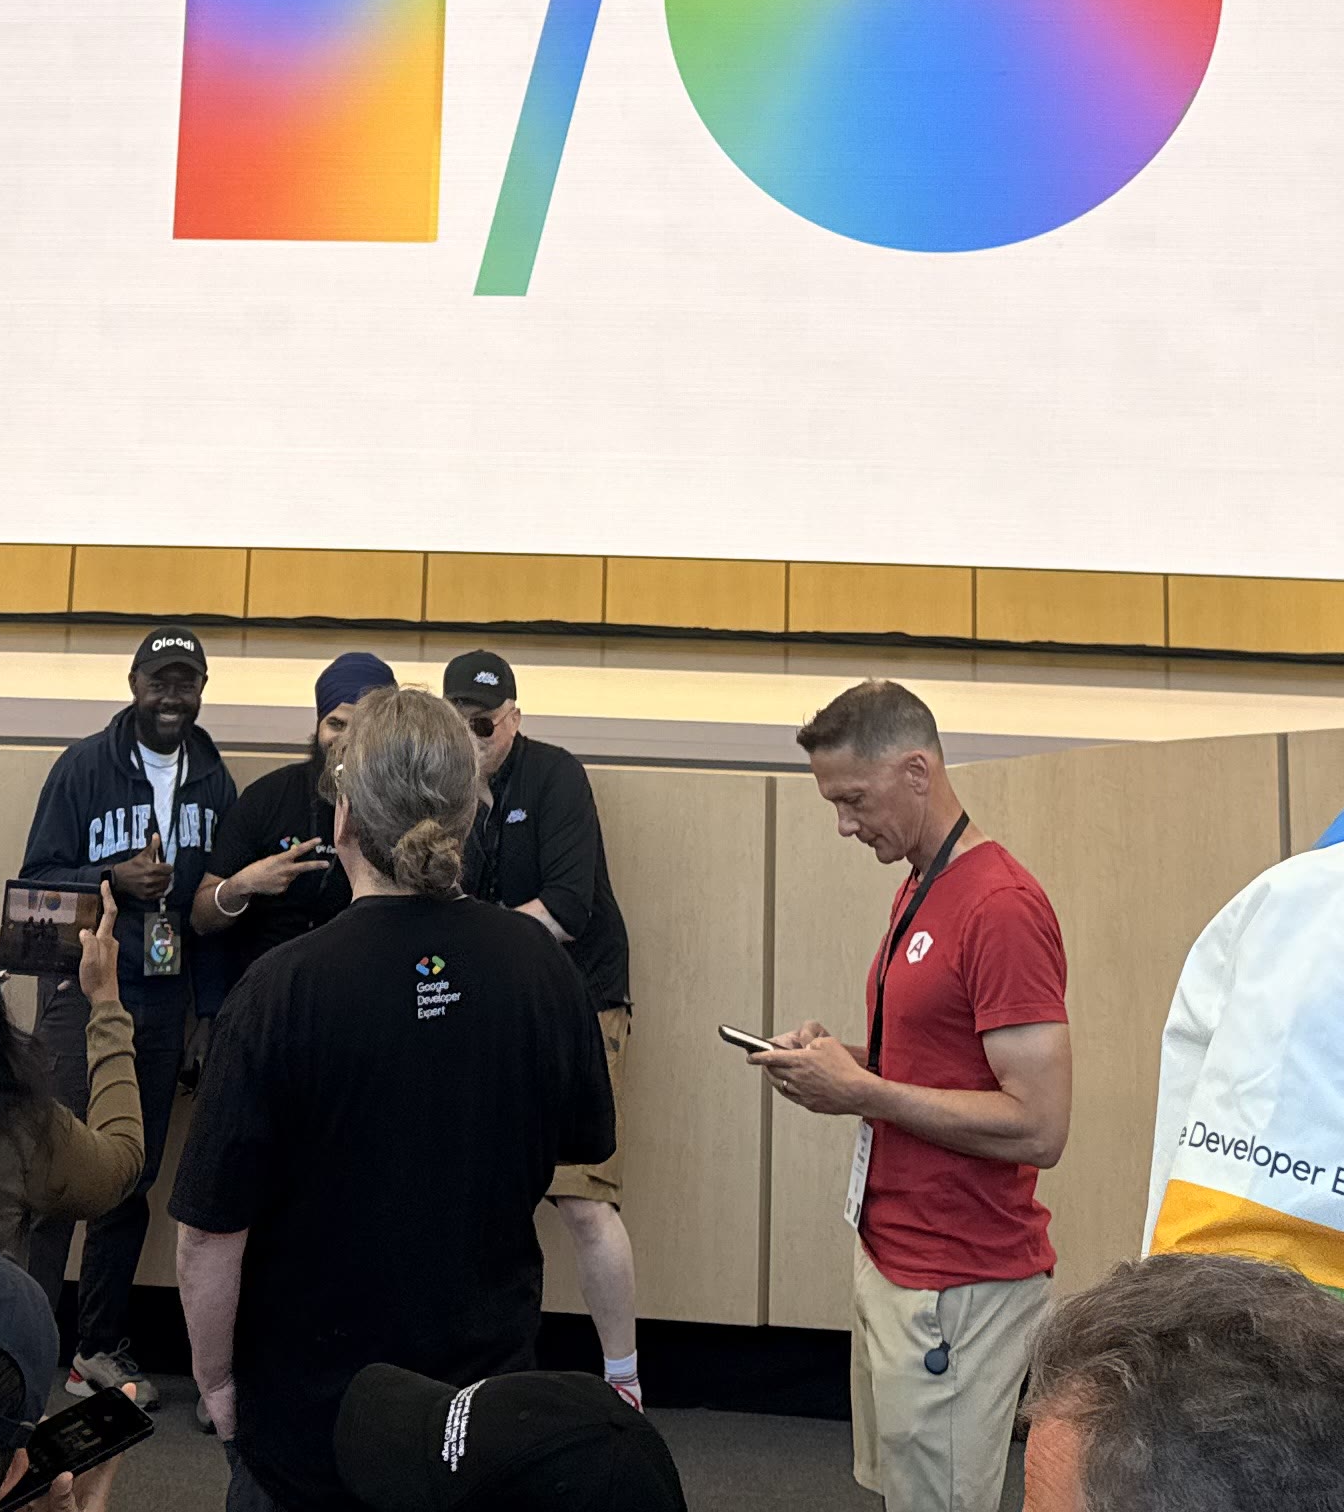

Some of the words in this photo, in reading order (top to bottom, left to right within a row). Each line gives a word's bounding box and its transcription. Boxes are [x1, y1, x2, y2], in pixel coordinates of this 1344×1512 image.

[416, 979, 450, 994] Google
[417, 991, 462, 1007] Developer
[417, 1005, 446, 1020] Expert
[1188, 1121, 1327, 1186] Developer
